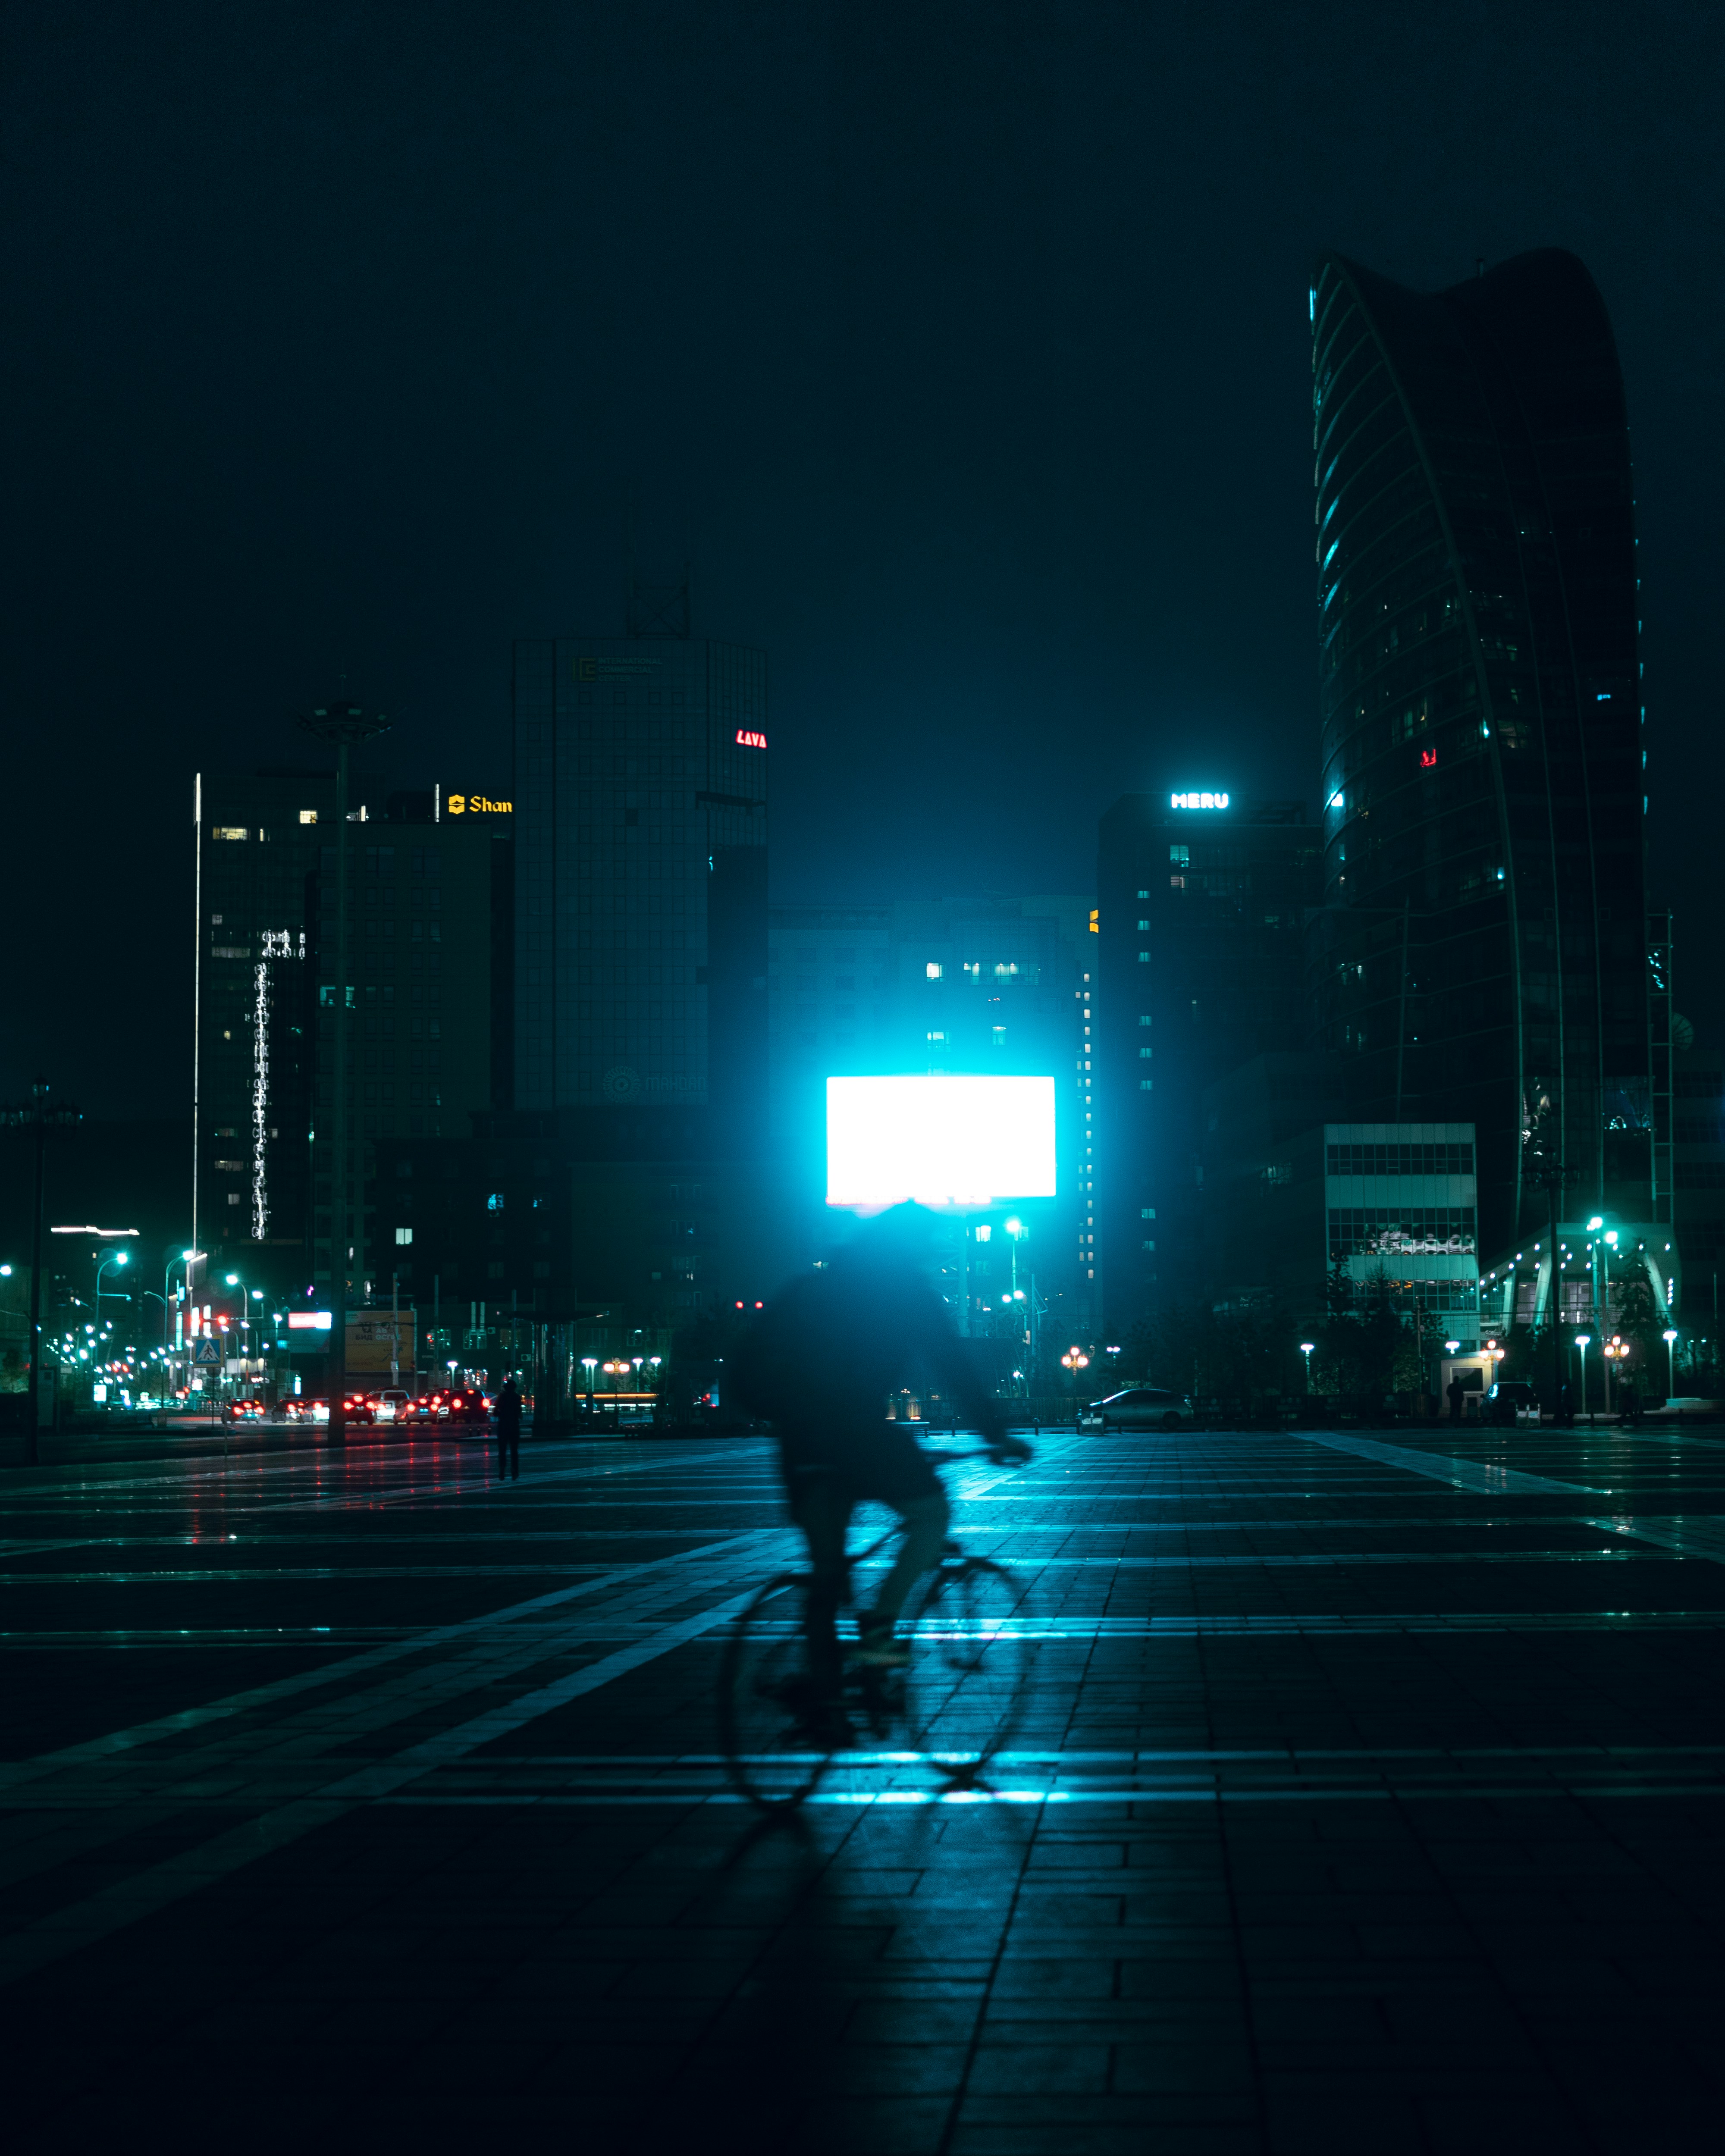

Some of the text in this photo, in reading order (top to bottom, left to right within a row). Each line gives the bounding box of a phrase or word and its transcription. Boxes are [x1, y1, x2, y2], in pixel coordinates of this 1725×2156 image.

[736, 729, 767, 749] LAVA
[469, 796, 513, 812] Shan
[1171, 793, 1229, 808] MERU
